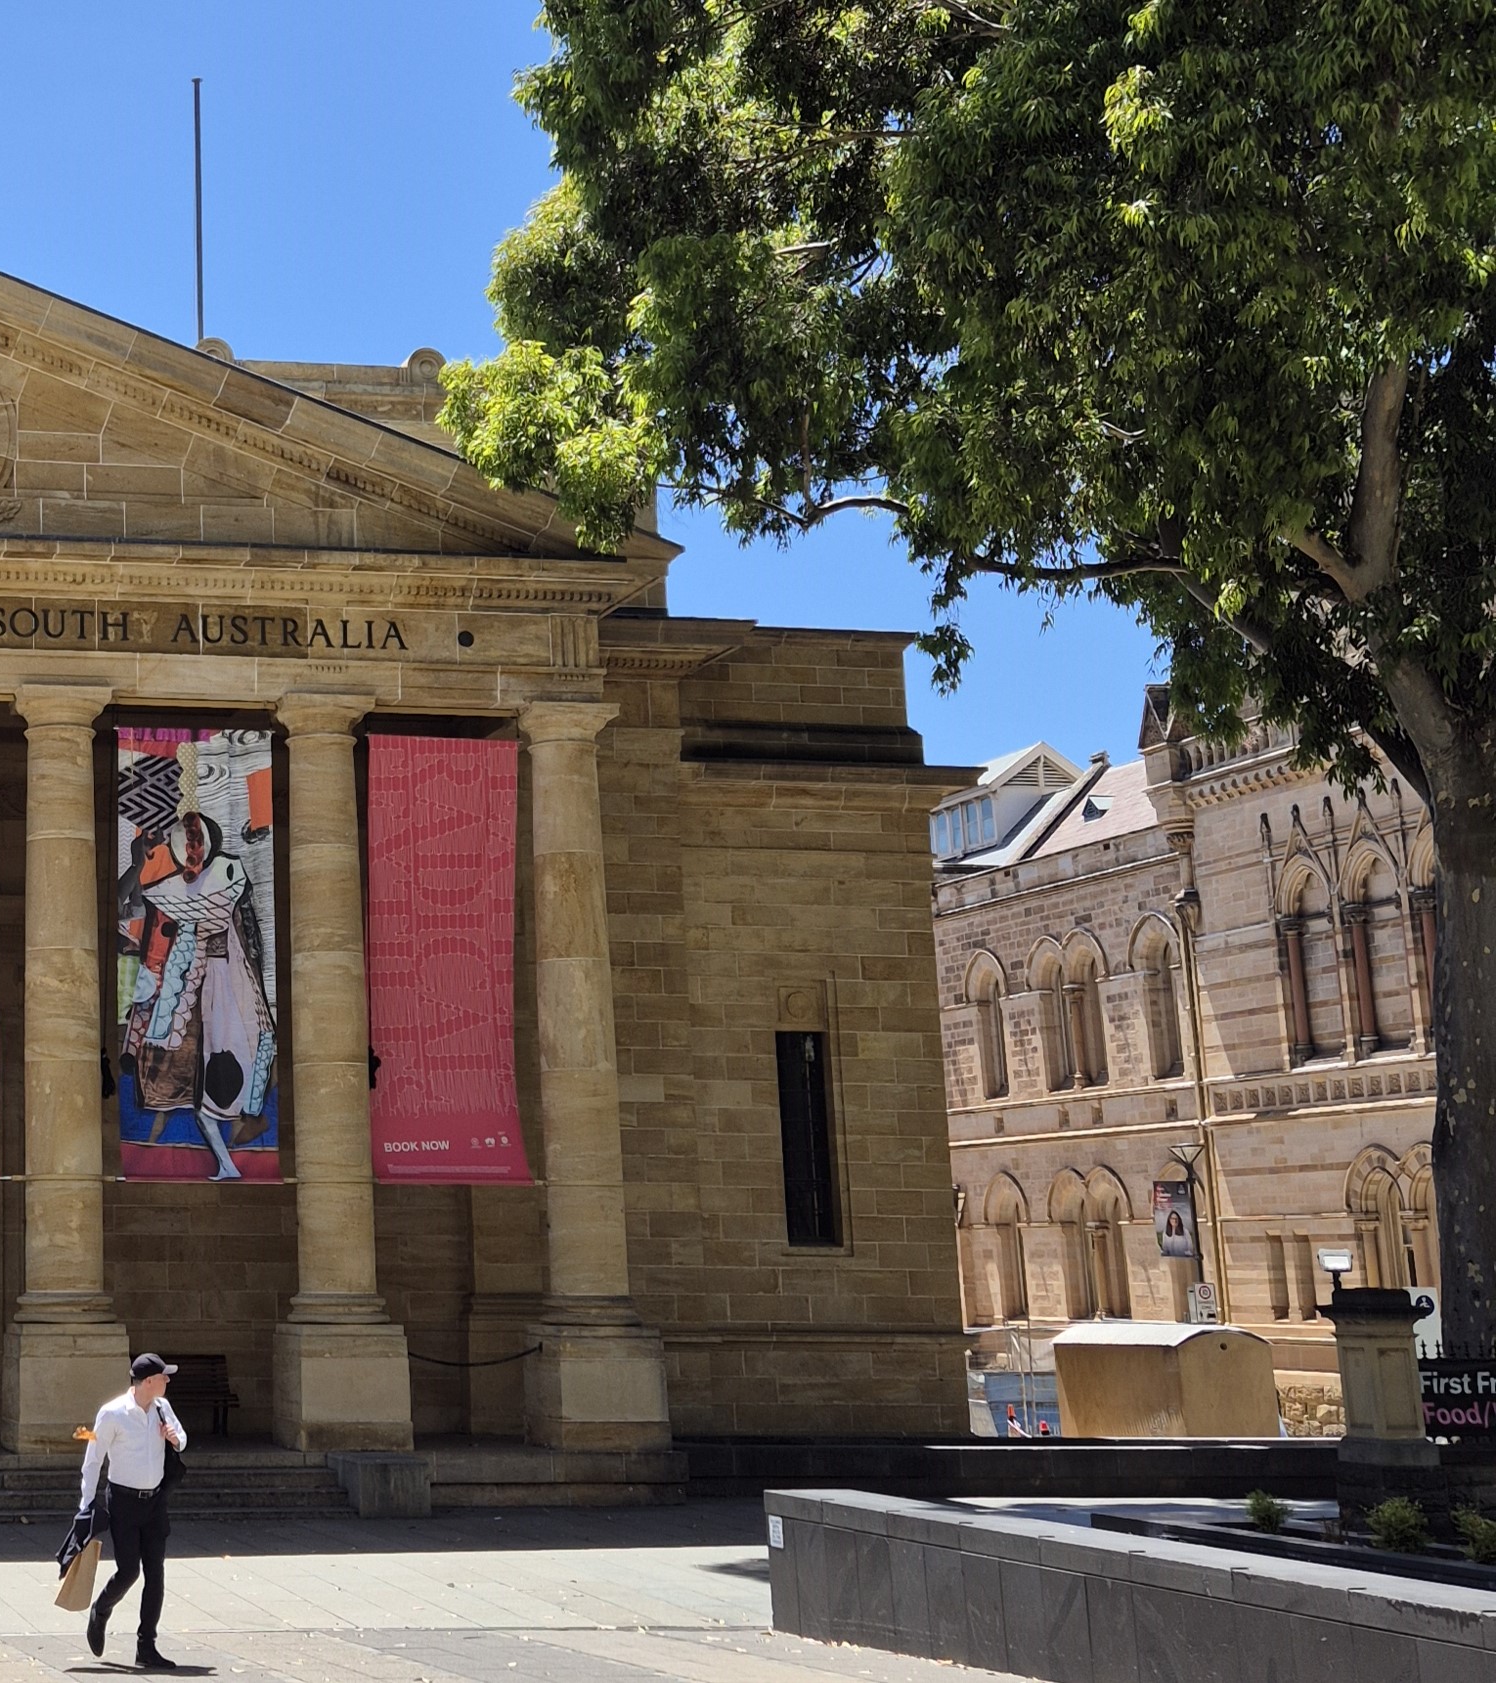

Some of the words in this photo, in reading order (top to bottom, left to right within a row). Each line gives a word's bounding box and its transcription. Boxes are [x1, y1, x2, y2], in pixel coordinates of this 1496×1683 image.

[172, 612, 409, 650] AUSTRALIA
[384, 1141, 419, 1153] BOOK
[421, 1140, 450, 1151] NOW
[1419, 1371, 1473, 1394] First
[1422, 1400, 1496, 1429] Food/
